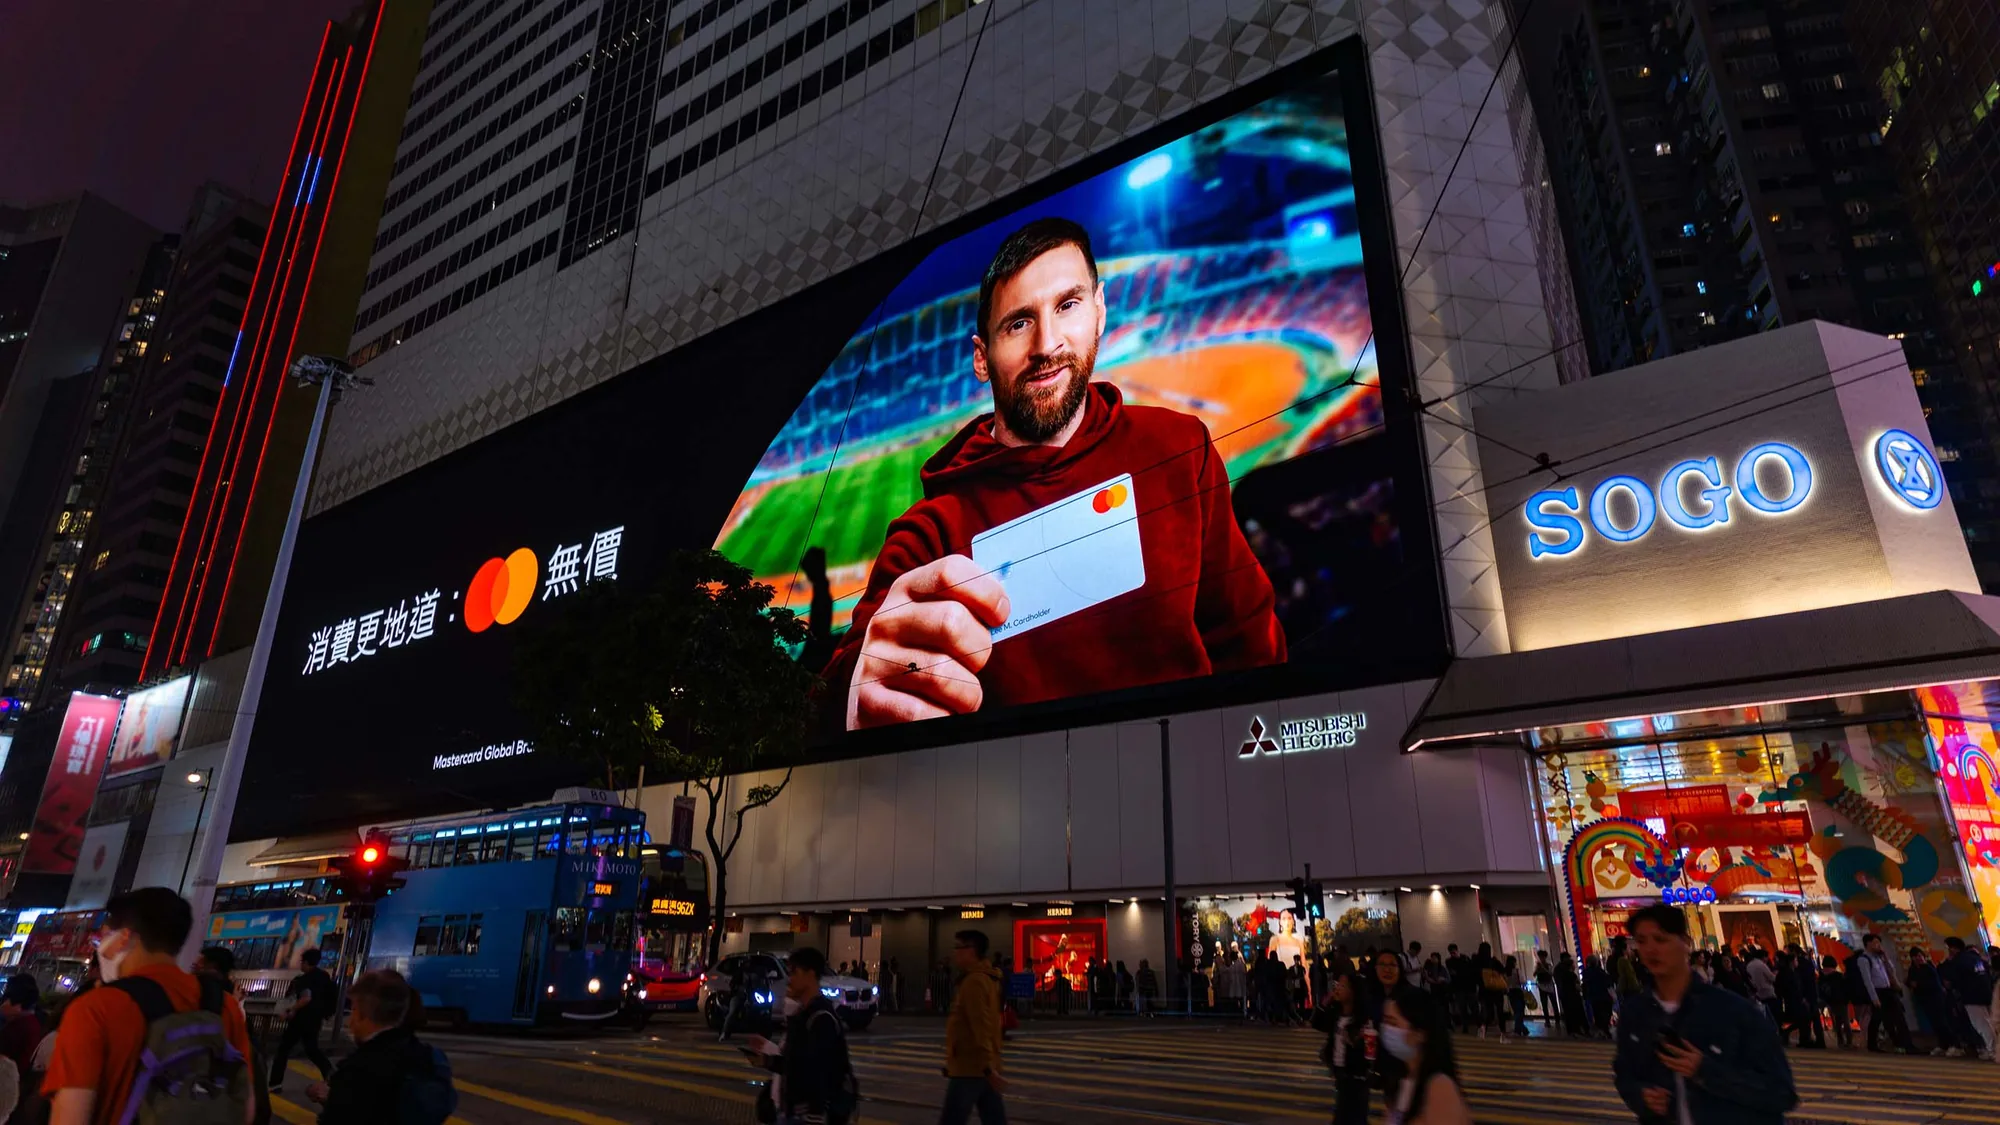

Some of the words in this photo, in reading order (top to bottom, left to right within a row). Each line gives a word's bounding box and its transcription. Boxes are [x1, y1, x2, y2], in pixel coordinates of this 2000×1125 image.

[1524, 441, 1814, 560] SOGO
[542, 525, 625, 602] 無價
[1003, 622, 1012, 631] M.
[1013, 608, 1051, 627] Cardholder
[1281, 713, 1366, 737] MITSUBISHI
[1282, 730, 1355, 751] ELECTRIC
[432, 746, 484, 770] Mastercard
[484, 740, 516, 760] Global
[590, 791, 608, 802] 80
[1662, 885, 1717, 905] SOGO
[676, 901, 695, 916] 962X
[1192, 912, 1200, 943] TORY
